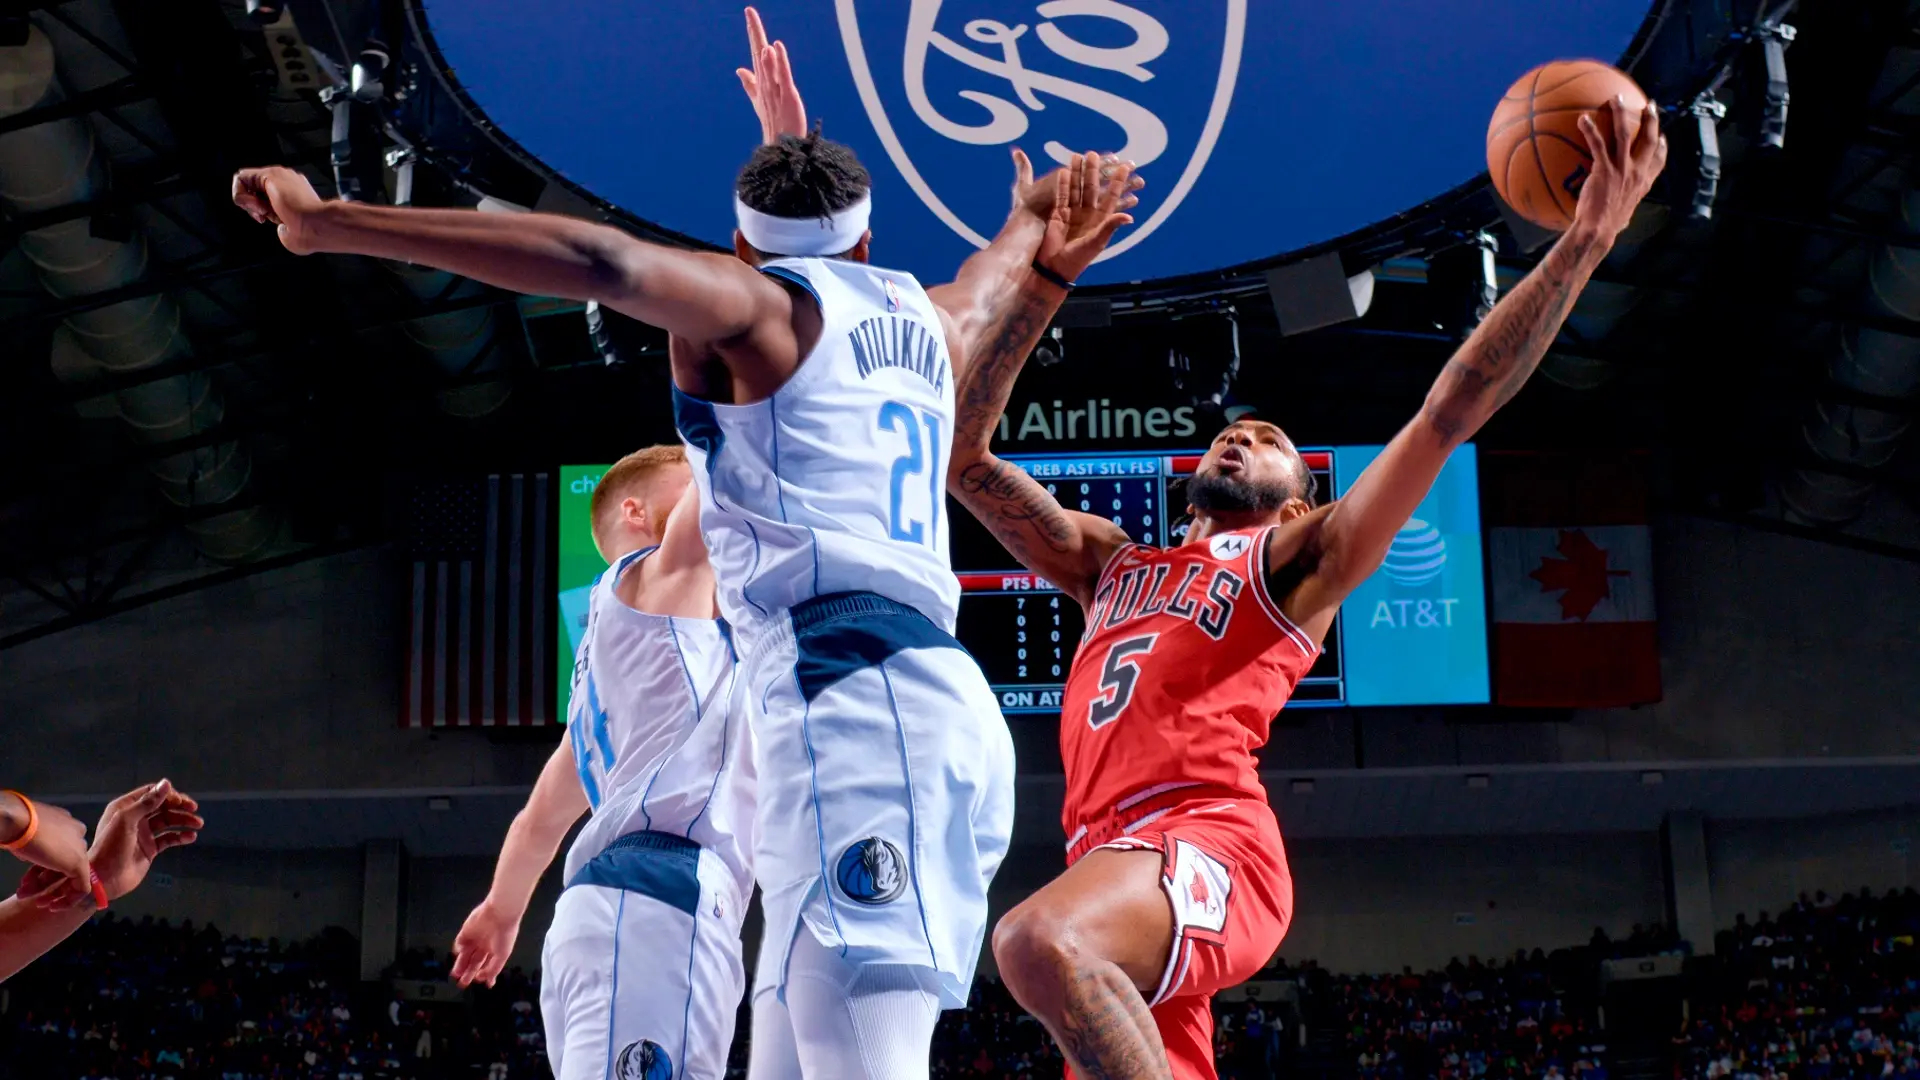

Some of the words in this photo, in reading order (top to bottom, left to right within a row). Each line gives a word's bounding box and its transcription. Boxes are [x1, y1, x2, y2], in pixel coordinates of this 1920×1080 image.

[848, 316, 946, 399] NTILIKINA
[1017, 399, 1197, 441] Airlines
[1032, 463, 1061, 476] REB
[1065, 463, 1094, 476] AST
[1099, 462, 1125, 475] STL
[1130, 461, 1156, 474] FLS
[878, 400, 941, 552] 21
[1080, 482, 1090, 495] 0
[1114, 482, 1121, 494] 1
[1144, 481, 1151, 493] 1
[1080, 500, 1090, 511] 0
[1112, 499, 1122, 511] 0
[1144, 498, 1152, 510] 1
[1142, 514, 1152, 527] 0
[1143, 532, 1153, 544] 0
[1002, 576, 1031, 590] PTS
[1017, 598, 1026, 609] 7
[1050, 597, 1059, 609] 4
[1017, 615, 1026, 627] 0
[1052, 614, 1060, 626] 1
[1370, 598, 1460, 629] AT&T
[1017, 631, 1027, 643] 3
[1050, 630, 1060, 642] 0
[1017, 648, 1027, 660] 0
[1053, 647, 1061, 659] 1
[1018, 665, 1027, 677] 2
[1051, 664, 1061, 676] 0
[1087, 632, 1161, 731] 5
[1002, 692, 1034, 707] ON
